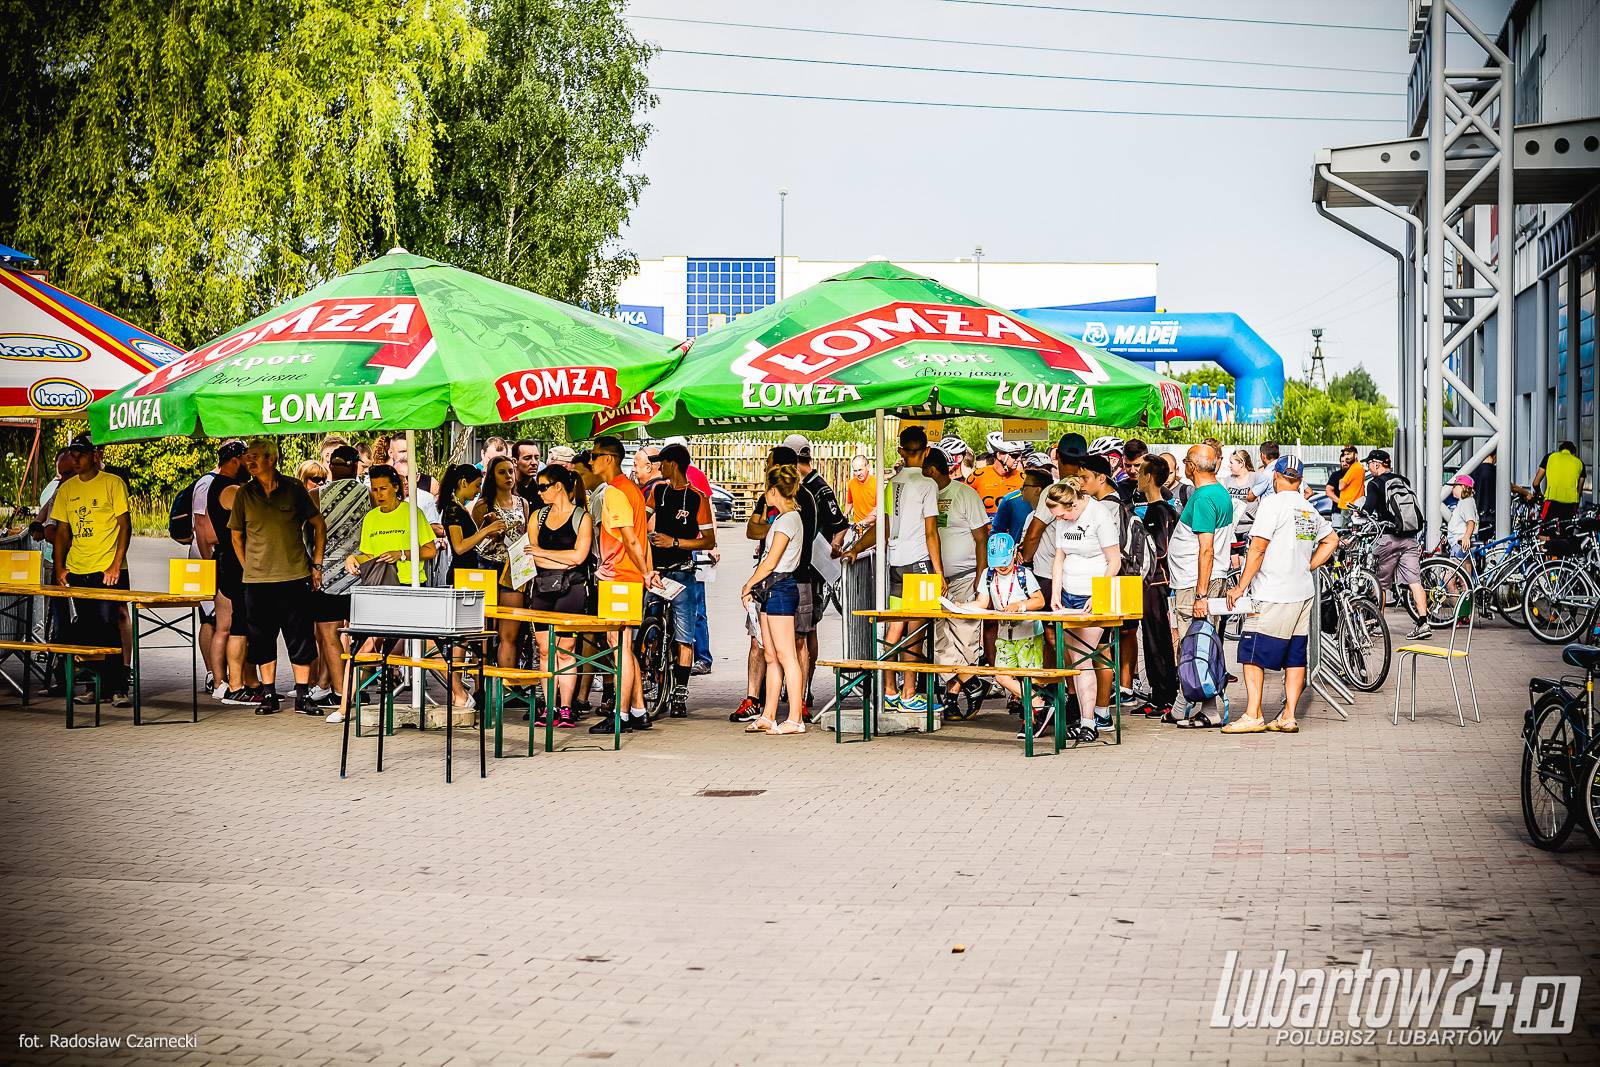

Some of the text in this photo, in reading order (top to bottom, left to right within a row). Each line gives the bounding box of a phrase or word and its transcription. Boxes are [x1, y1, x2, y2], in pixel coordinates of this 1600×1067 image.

[164, 303, 415, 381] ŁOMŻA
[764, 306, 1041, 375] ŁOMŻA
[1113, 325, 1179, 344] MAPEI
[40, 388, 82, 406] koral
[501, 368, 610, 409] ŁOMŻA
[742, 382, 863, 408] ŁOMŻA
[995, 379, 1098, 417] ŁOMŻA
[108, 397, 163, 430] ŁOMŻA
[262, 392, 381, 424] ŁOMŻA
